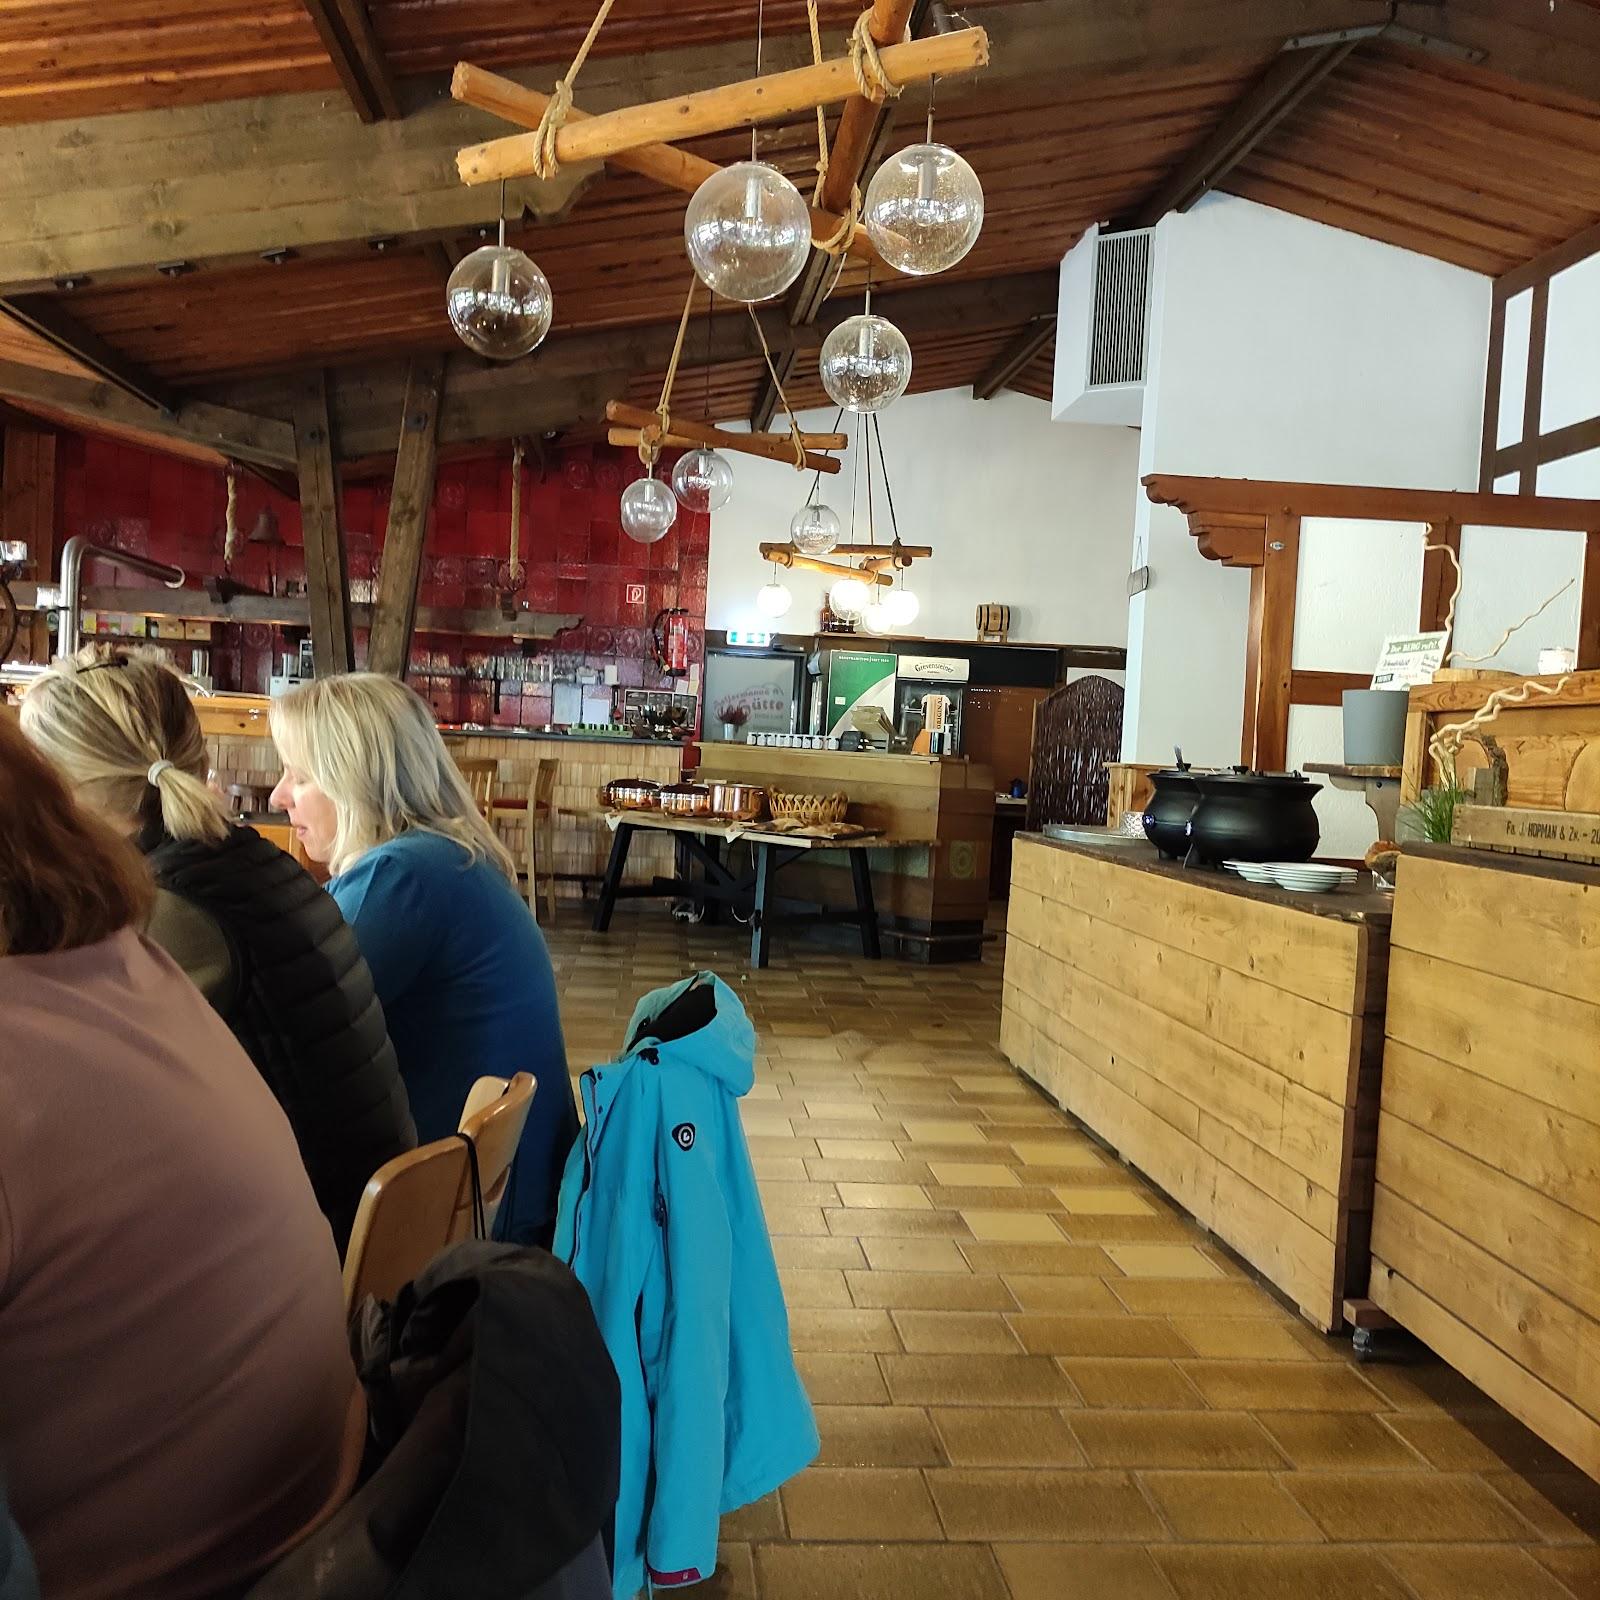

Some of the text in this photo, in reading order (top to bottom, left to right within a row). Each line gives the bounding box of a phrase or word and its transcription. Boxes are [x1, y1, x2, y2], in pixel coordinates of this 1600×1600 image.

[914, 663, 954, 673] Grevensteiner
[1527, 822, 1557, 840] HOPMAN
[1559, 825, 1565, 841] &
